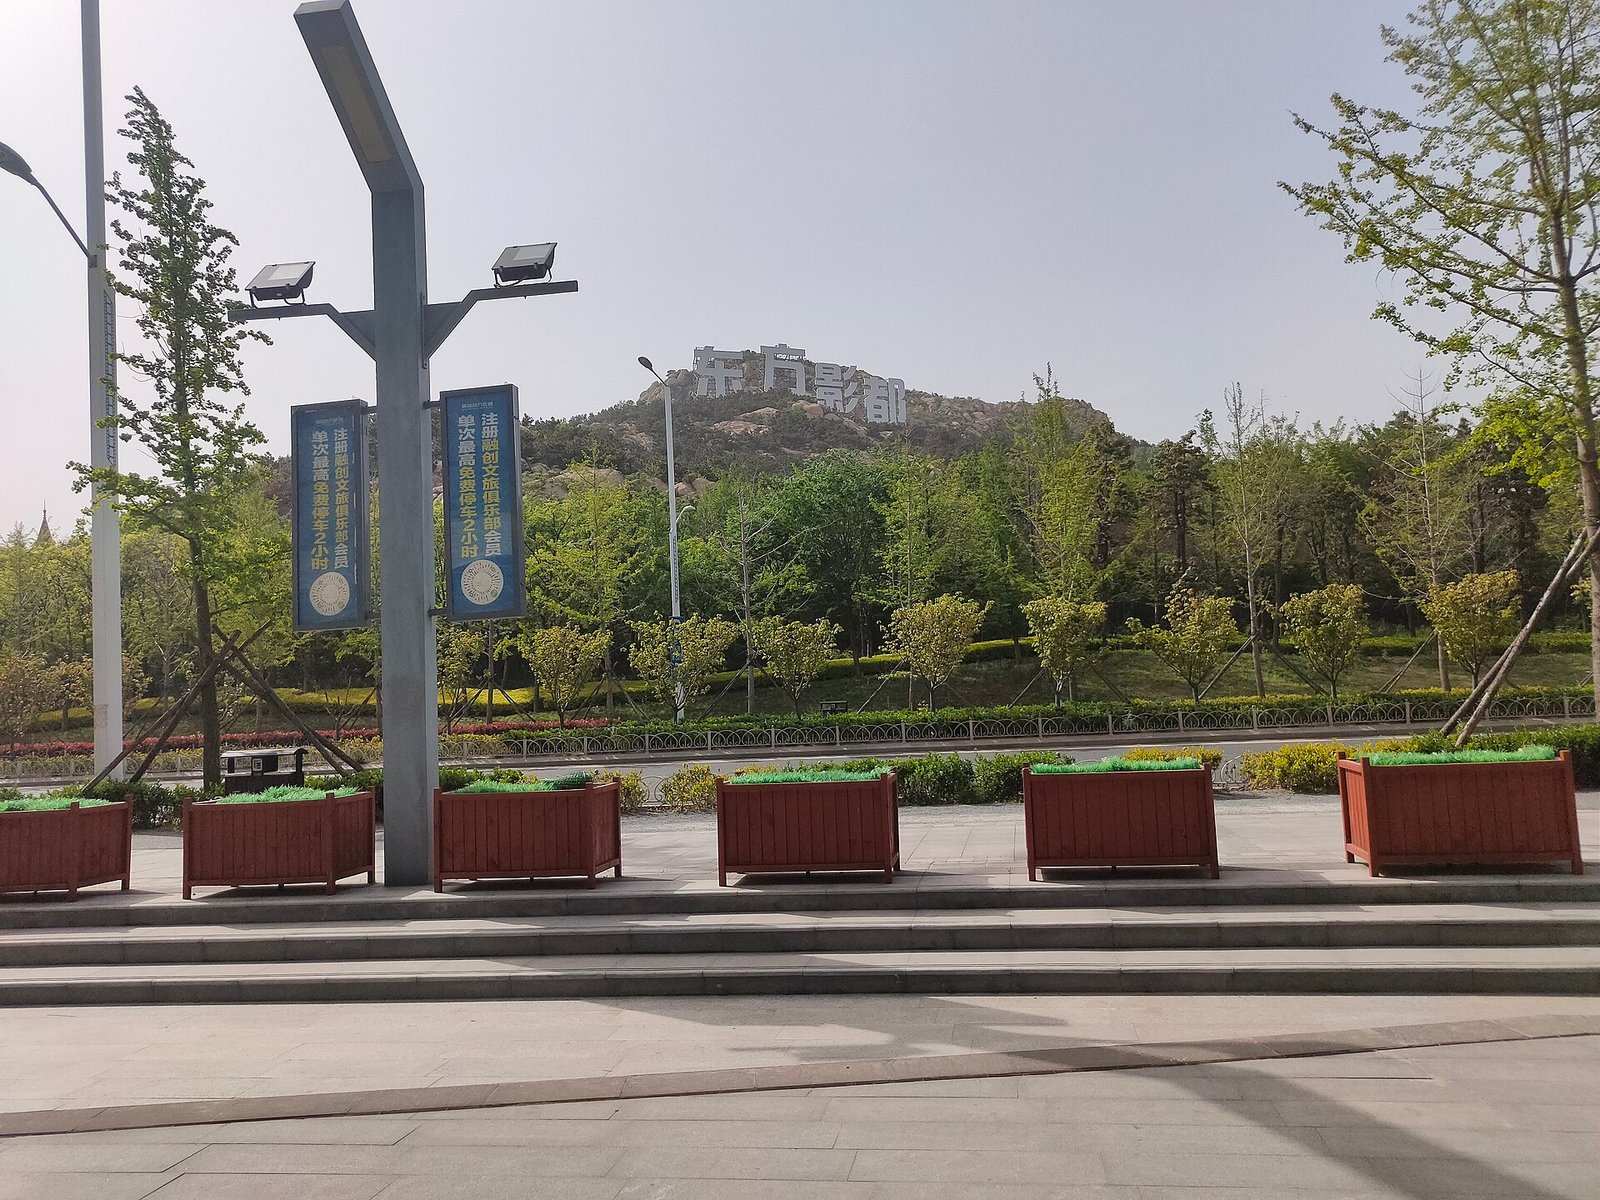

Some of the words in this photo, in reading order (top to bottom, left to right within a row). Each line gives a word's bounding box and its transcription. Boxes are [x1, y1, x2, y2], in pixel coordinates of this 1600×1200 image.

[693, 343, 907, 424] 东方影都
[310, 430, 330, 571] 单次最高免费停车2小时
[333, 427, 349, 570] 注册融创文旅俱乐部会员
[457, 414, 479, 558] 单次最高免费停车2小时
[481, 412, 502, 557] 注册融创文旅俱乐部会员
